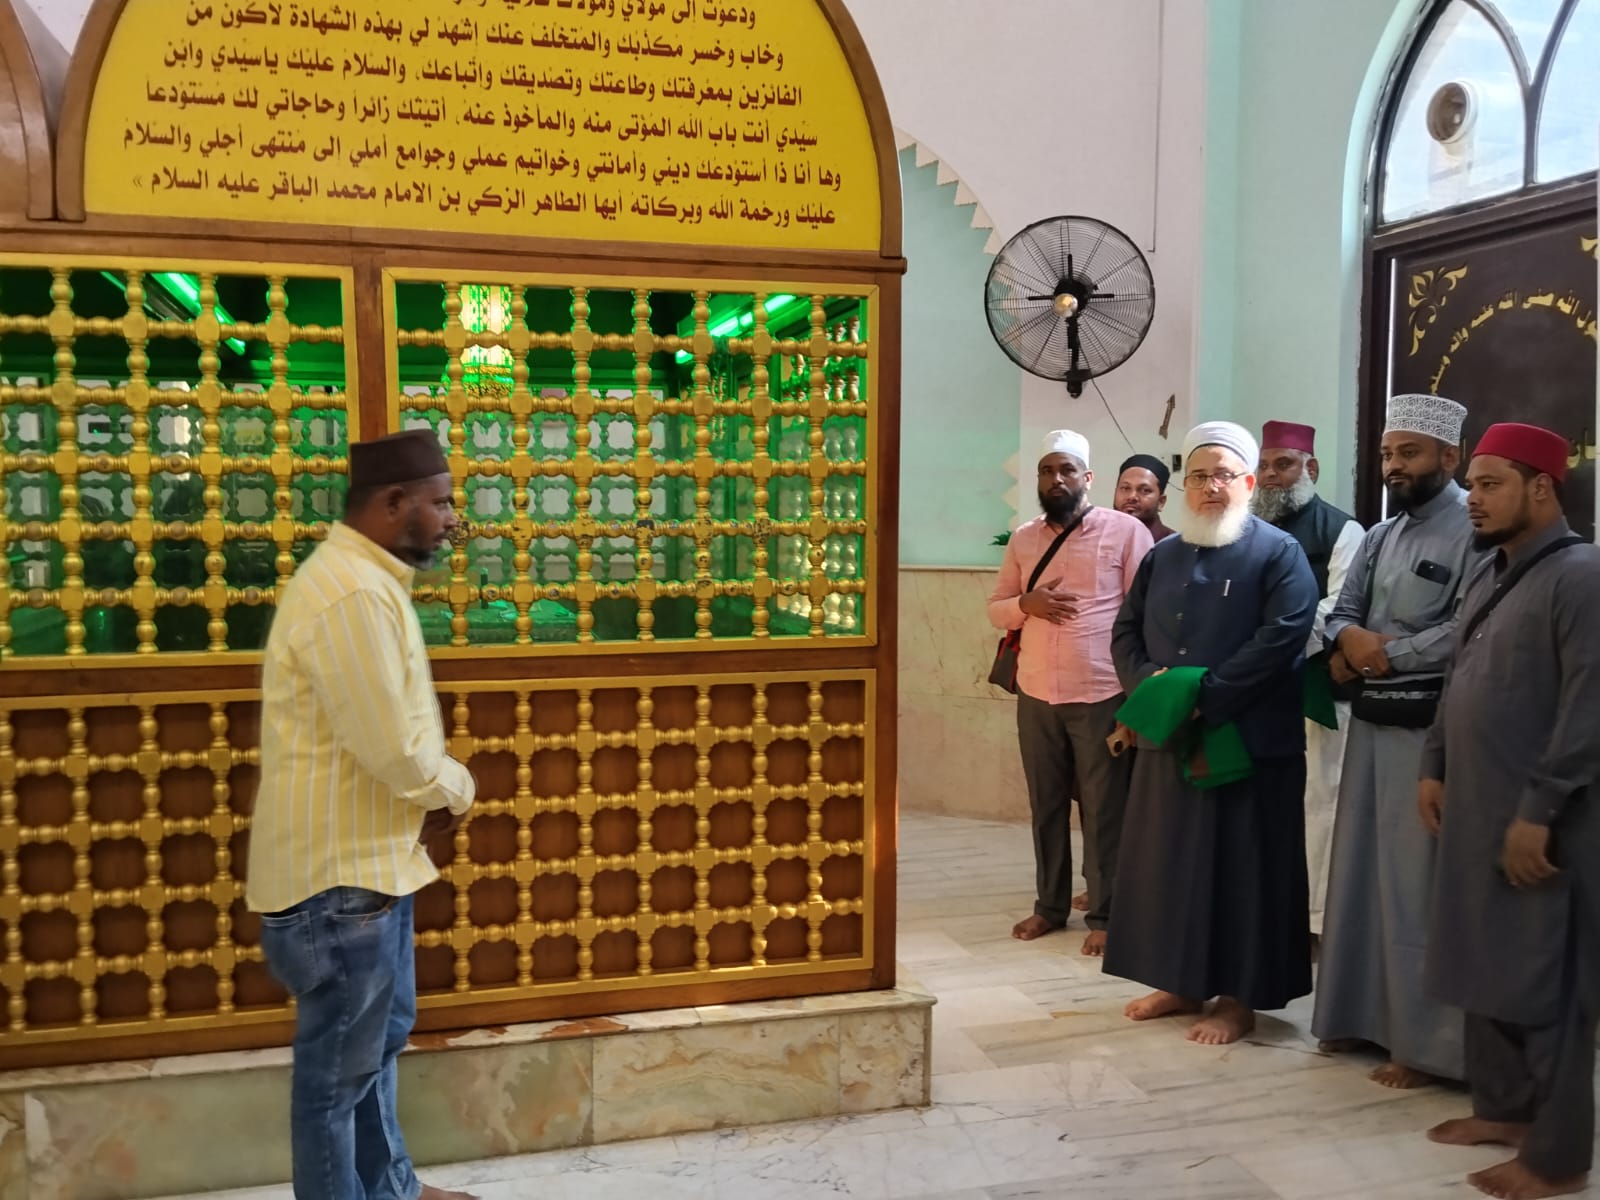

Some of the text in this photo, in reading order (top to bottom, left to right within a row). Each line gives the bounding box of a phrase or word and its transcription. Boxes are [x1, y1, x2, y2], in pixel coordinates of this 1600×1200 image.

[185, 0, 214, 27] من
[289, 4, 358, 37] الشهادة
[363, 11, 403, 43] بهذه
[409, 16, 430, 47] لي
[485, 21, 525, 46] عنك
[530, 25, 611, 59] والمتخلف
[616, 29, 684, 61] مكذبك
[286, 47, 335, 78] عليك
[342, 51, 407, 84] والسلام
[689, 39, 735, 68] وخسر
[740, 42, 784, 71] وخاب
[500, 62, 583, 98] وتصديقك
[588, 70, 656, 102] وطاعتك
[661, 75, 733, 108] بمعرفتك
[232, 86, 259, 110] لك
[265, 90, 346, 122] وحاجاتي
[738, 81, 803, 111] الفائزين
[123, 120, 192, 153] والسلام
[582, 110, 612, 135] منه
[676, 115, 704, 140] الله
[708, 118, 737, 150] باب
[742, 119, 771, 145] أنت
[775, 121, 818, 152] سيدي
[199, 123, 243, 159] أجلي
[250, 128, 307, 161] منتهى
[348, 133, 388, 169] أملي
[395, 140, 456, 171] وجوامع
[462, 144, 508, 175] عملي
[514, 148, 581, 178] وخواتيم
[652, 155, 691, 187] ديني
[775, 159, 789, 184] ذا
[793, 160, 811, 185] أنا
[151, 165, 210, 195] السلام
[216, 170, 260, 200] عليه
[266, 172, 320, 204] الباقر
[326, 180, 377, 201] محمد
[818, 166, 842, 192] وها
[438, 186, 462, 213] بن
[467, 185, 526, 217] الزكي
[532, 189, 588, 217] الطاهر
[630, 191, 703, 226] وبركاته
[708, 195, 734, 221] الله
[740, 197, 791, 228] ورحمة
[796, 202, 836, 230] عليك
